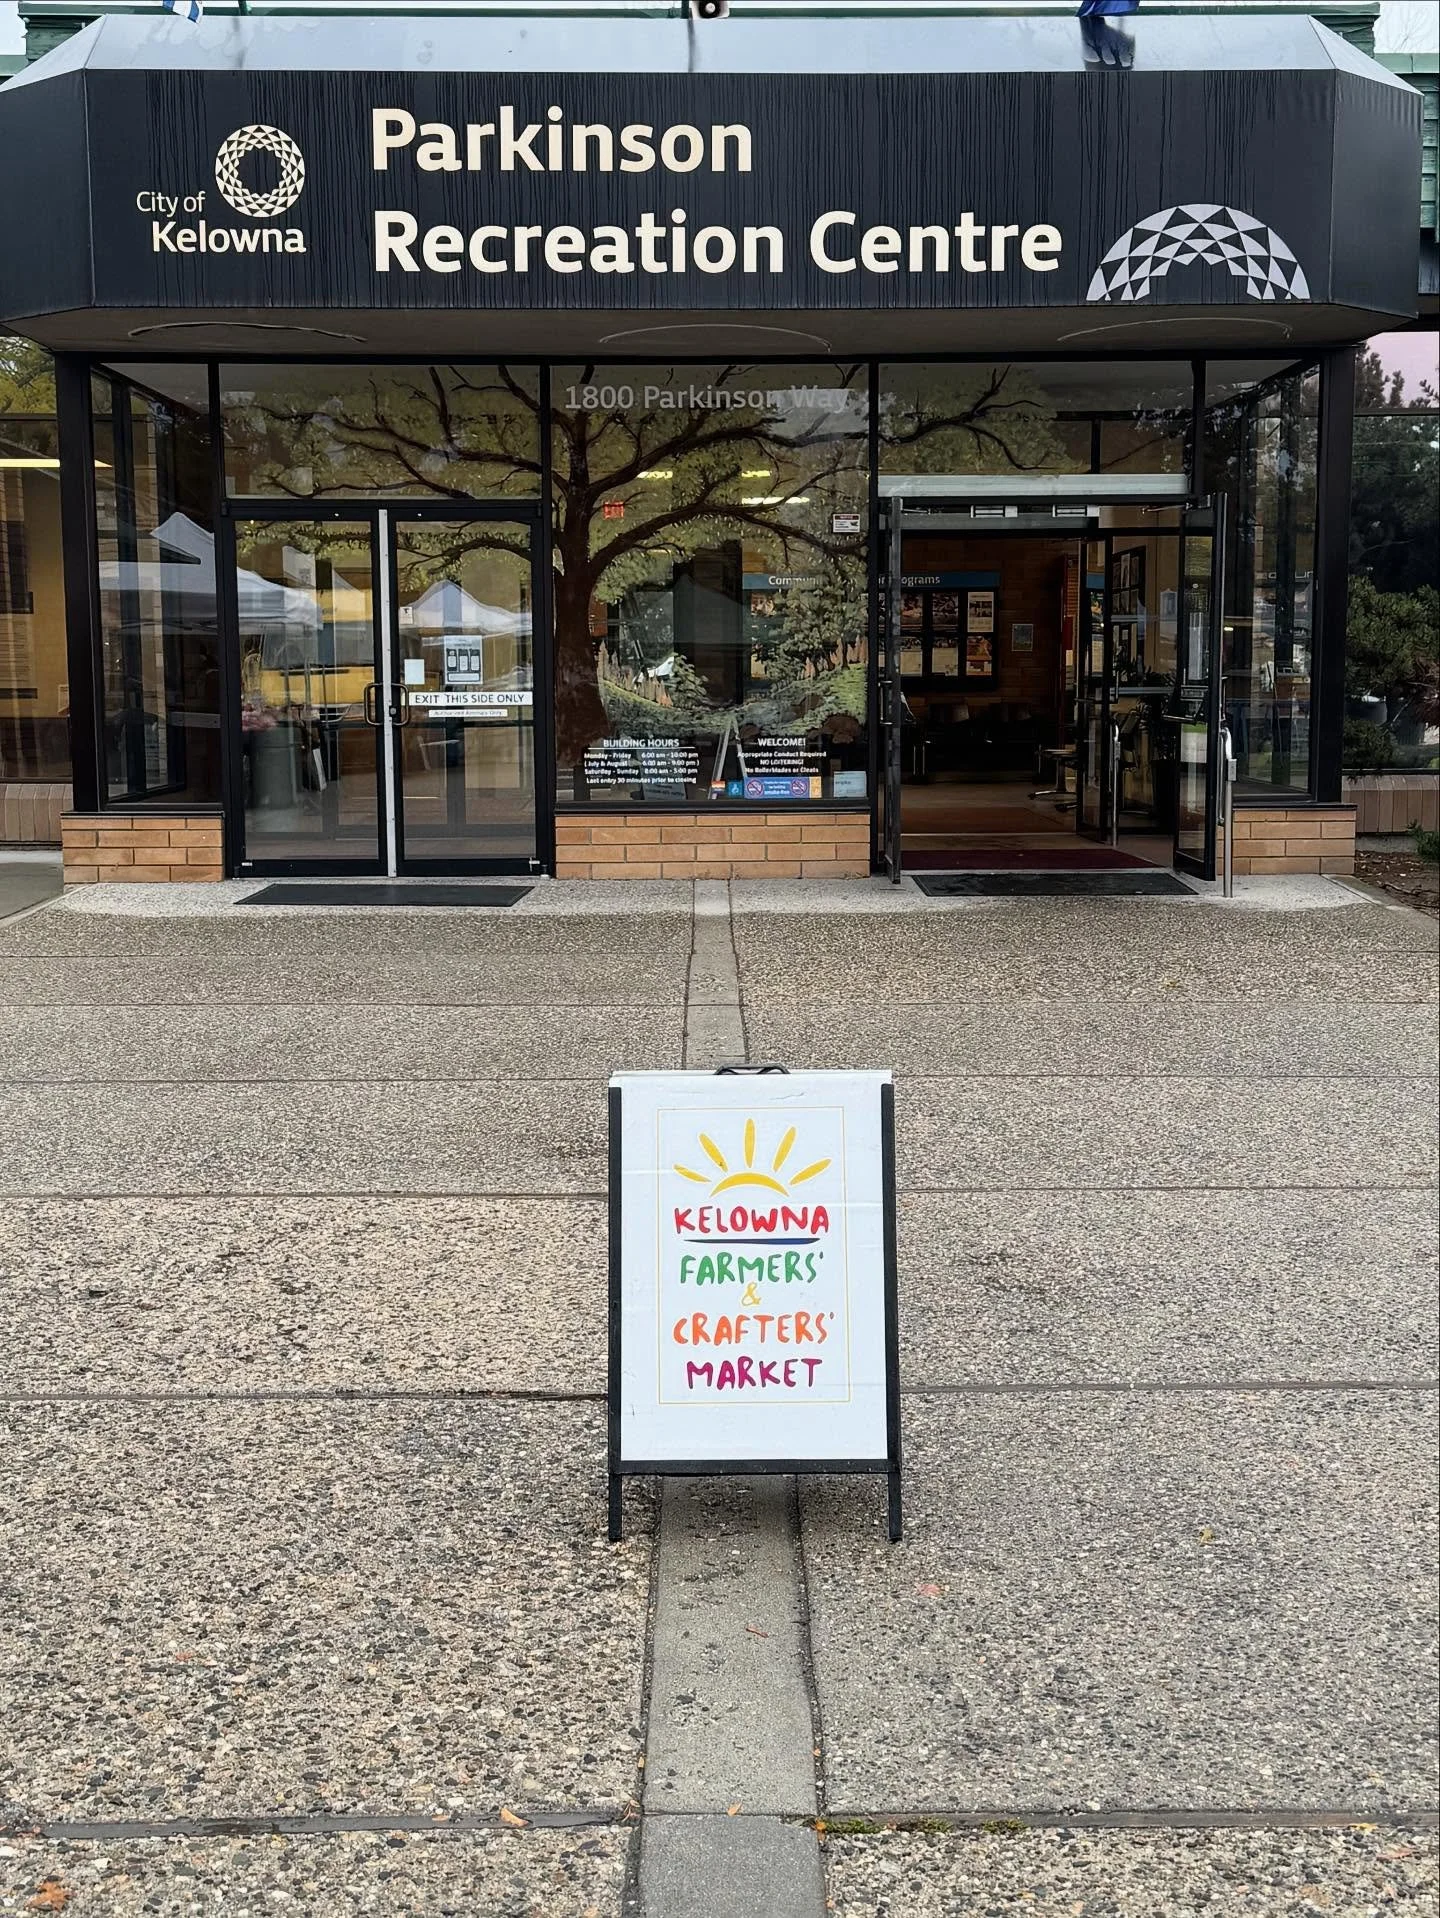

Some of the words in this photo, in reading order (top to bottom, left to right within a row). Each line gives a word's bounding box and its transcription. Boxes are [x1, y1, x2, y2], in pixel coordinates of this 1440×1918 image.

[372, 105, 751, 173] Parkinson
[136, 191, 179, 216] City
[183, 190, 206, 213] of
[152, 219, 307, 254] Kelowna
[374, 208, 784, 274] Recreation
[810, 210, 1063, 274] Centre
[565, 385, 634, 409] 1800
[644, 384, 779, 409] Parkinson
[790, 385, 850, 414] Way
[414, 694, 439, 704] EXIT
[444, 694, 468, 704] THIS
[471, 694, 494, 703] SIDE
[496, 694, 525, 703] ONLY
[603, 739, 646, 748] BUILDING
[647, 738, 680, 747] HOURS
[757, 738, 806, 747] WELCOME!
[583, 752, 608, 760] Monday
[612, 752, 632, 760] Friday
[588, 760, 600, 768] July
[606, 760, 628, 768] August
[584, 768, 612, 776] Saturday
[616, 768, 639, 776] Sunday
[600, 777, 617, 785] entry
[651, 777, 667, 785] prior
[673, 1205, 829, 1235] KELOWNA
[680, 1250, 825, 1286] FARMERS'
[741, 1282, 761, 1307] &
[672, 1311, 835, 1347] CRAFTERS'
[686, 1355, 823, 1391] MARKET
